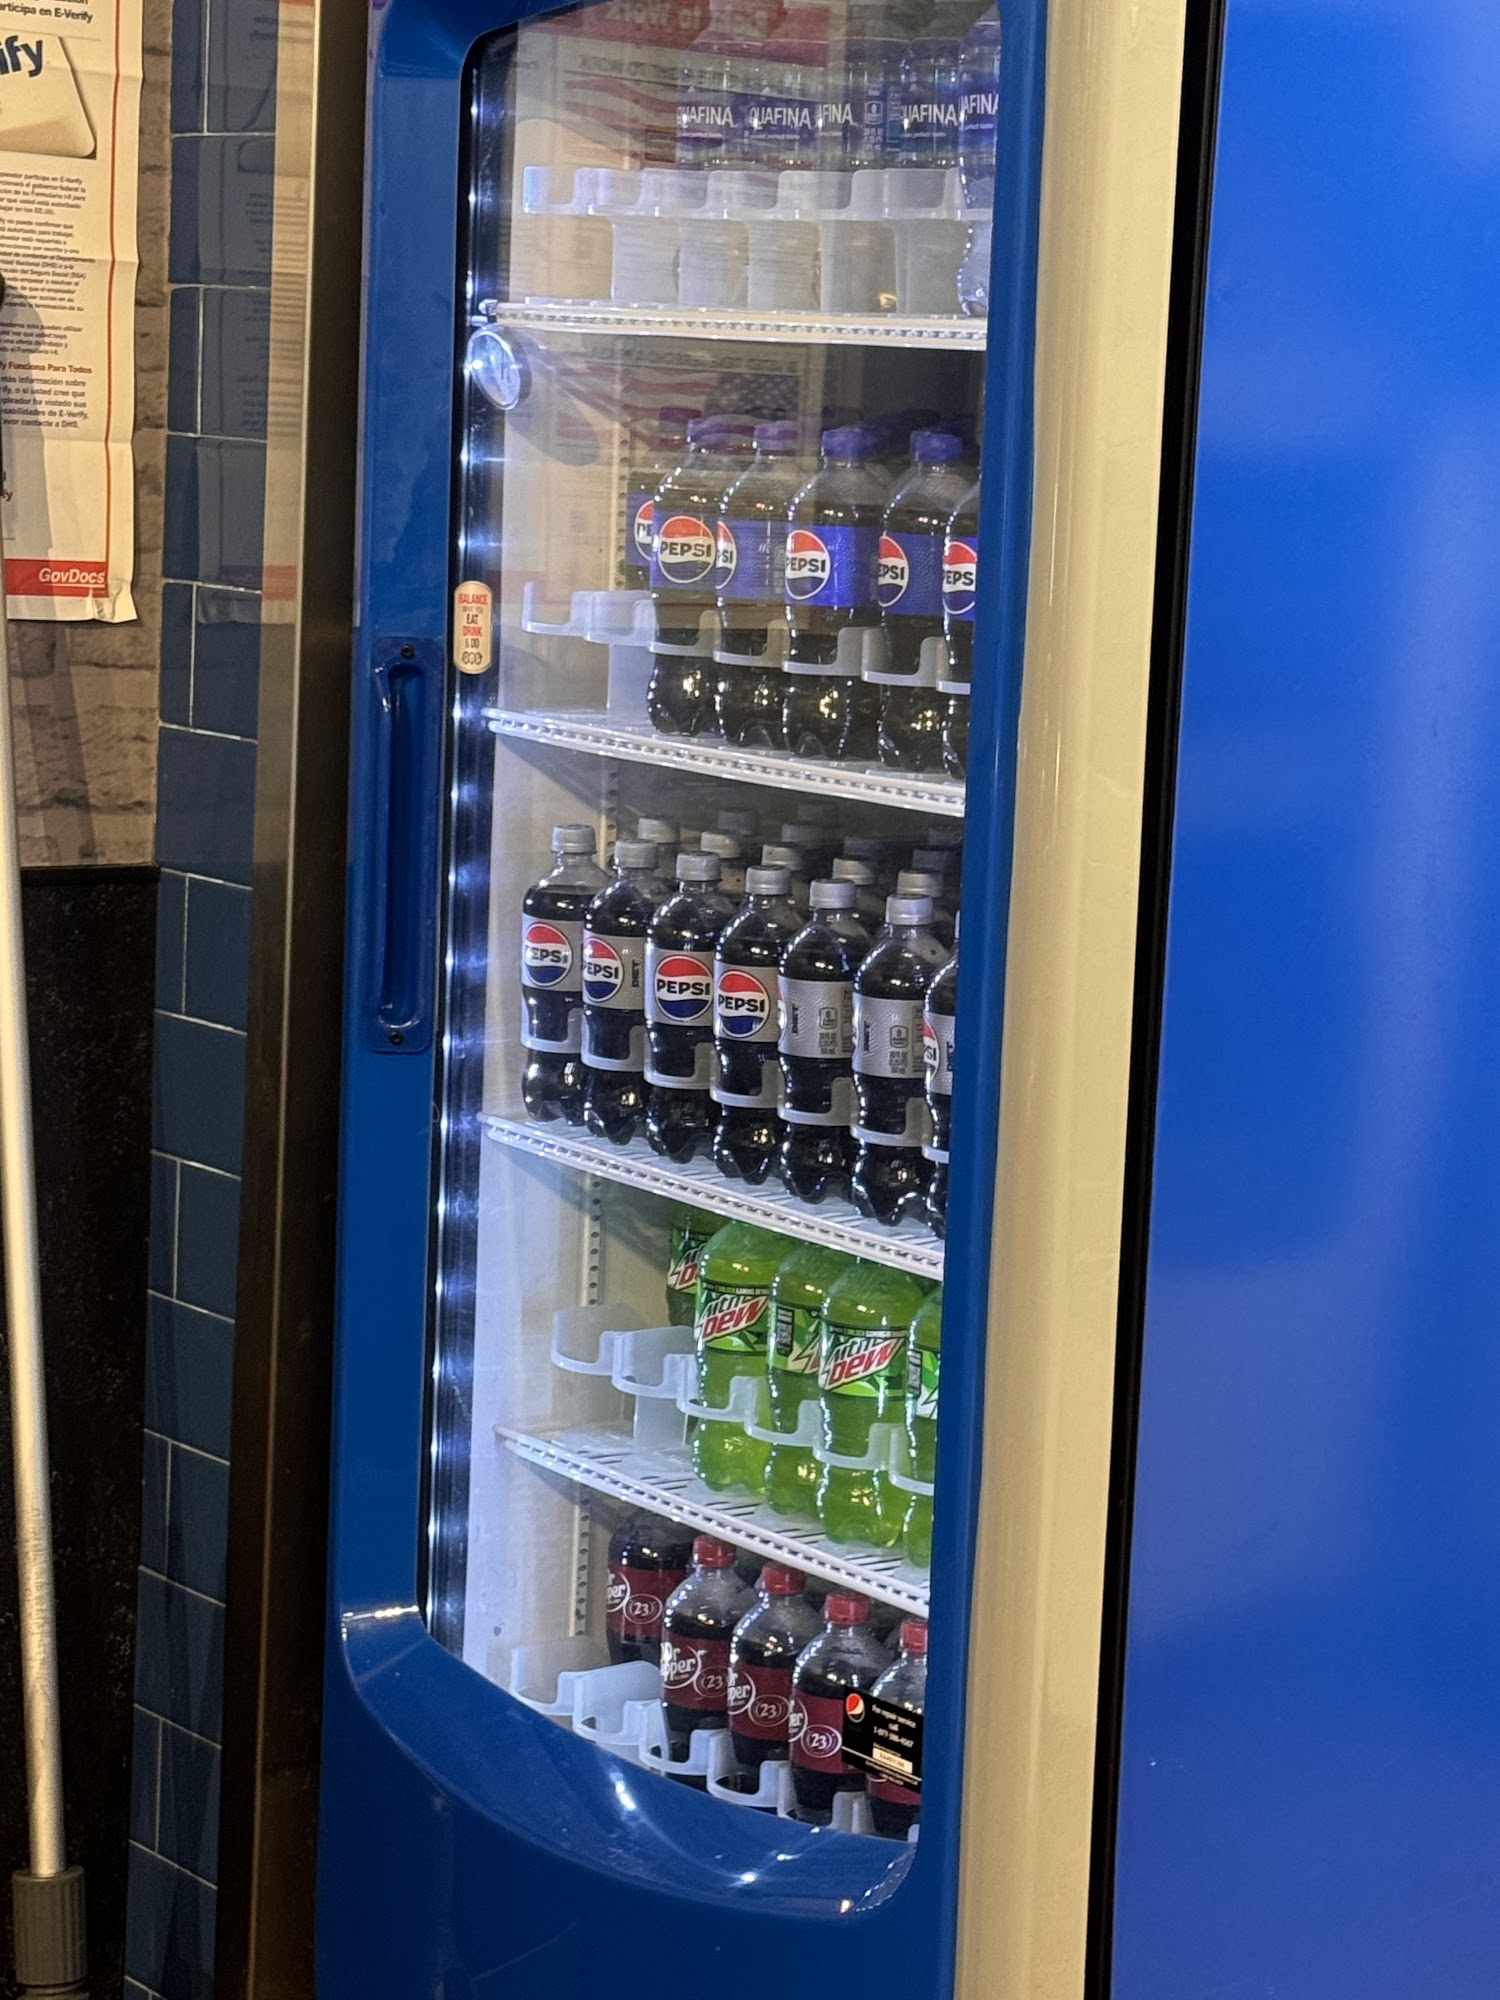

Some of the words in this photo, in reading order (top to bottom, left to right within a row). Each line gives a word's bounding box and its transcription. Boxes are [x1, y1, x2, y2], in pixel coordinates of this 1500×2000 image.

[39, 8, 52, 17] en
[54, 8, 93, 24] E-Verify
[47, 363, 67, 372] Para
[68, 365, 93, 374] Todos
[660, 542, 712, 560] PEPSI
[786, 556, 826, 578] EPSI
[38, 567, 106, 585] GovDocs
[943, 569, 974, 588] EPS
[458, 593, 489, 605] BALANCE
[466, 613, 479, 625] EAT
[656, 978, 710, 997] PEPSI
[718, 993, 765, 1013] PEPSI
[634, 1602, 649, 1617] 23
[706, 1675, 723, 1690] 23
[760, 1703, 777, 1718] 23
[810, 1733, 826, 1750] 23
